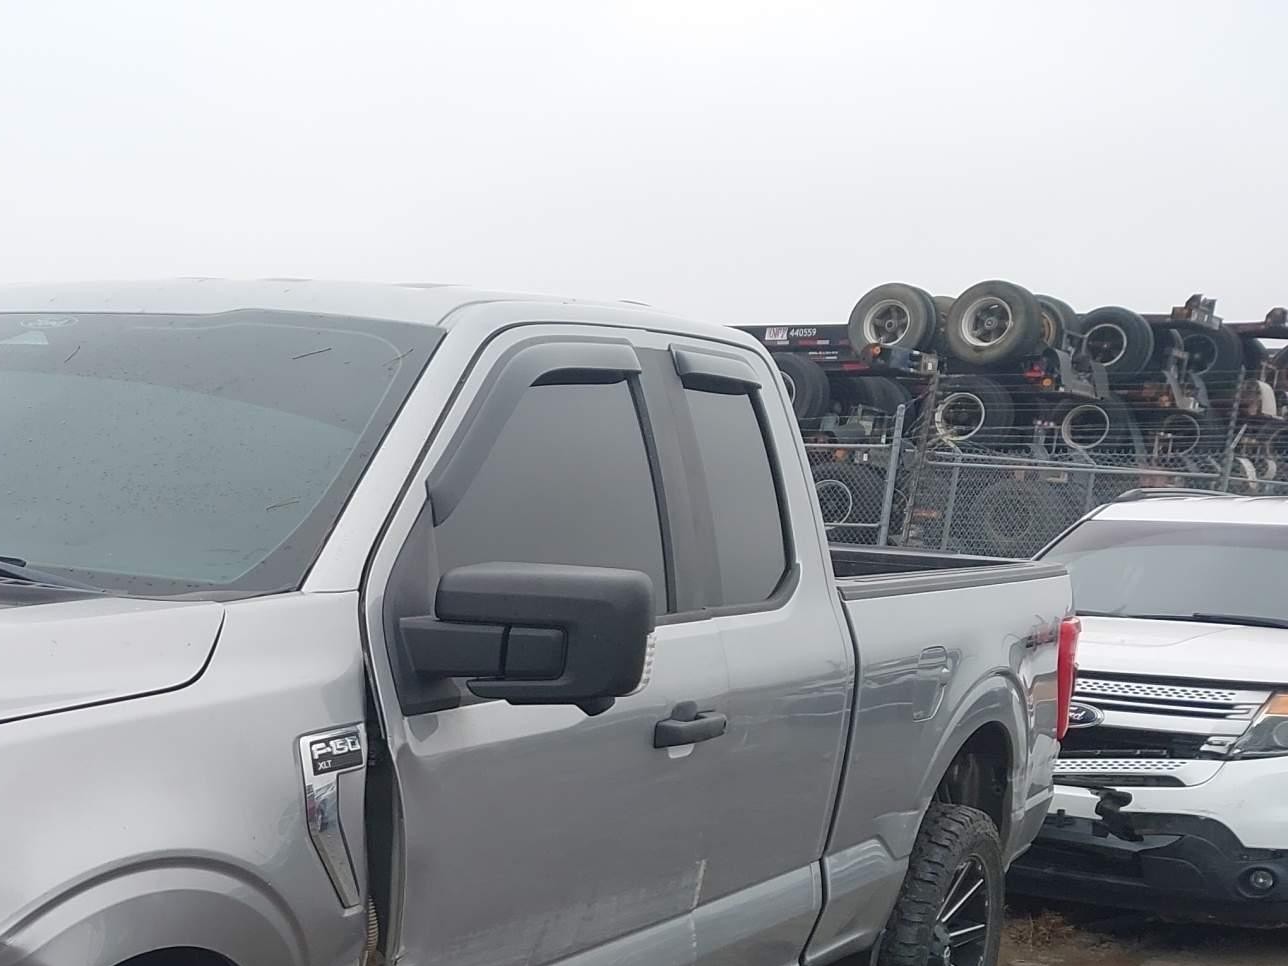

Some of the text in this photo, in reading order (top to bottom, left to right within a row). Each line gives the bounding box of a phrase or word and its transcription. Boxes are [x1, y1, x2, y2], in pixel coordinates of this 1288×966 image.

[789, 328, 817, 337] 440559
[312, 735, 361, 760] F-150
[317, 760, 332, 771] XLT
